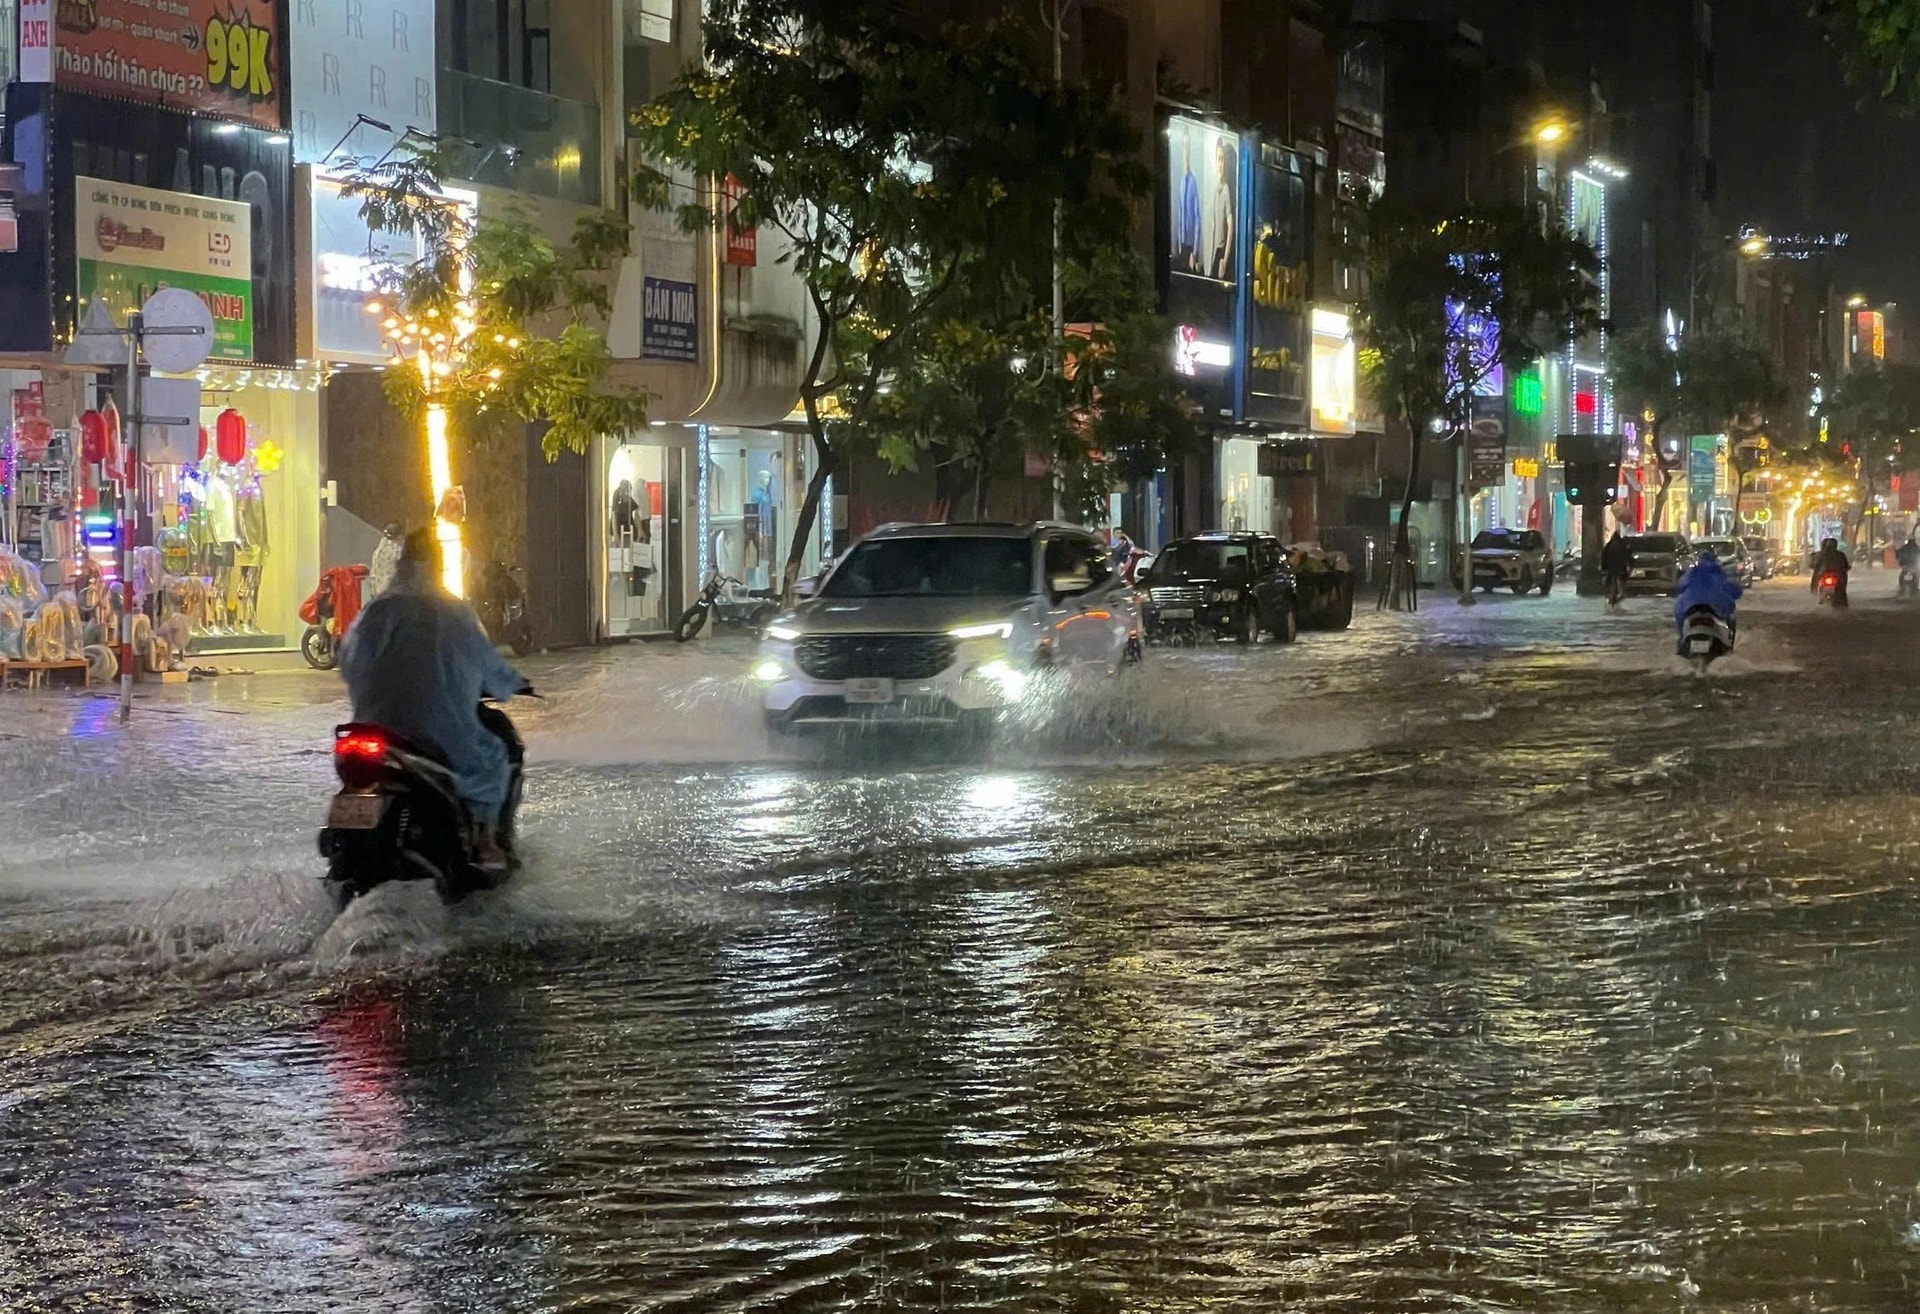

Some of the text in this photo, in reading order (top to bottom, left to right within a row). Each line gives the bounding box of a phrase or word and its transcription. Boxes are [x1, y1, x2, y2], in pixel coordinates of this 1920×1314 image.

[22, 20, 48, 47] ANH
[206, 18, 272, 96] 99K
[150, 66, 186, 95] chưa
[208, 231, 232, 254] LED
[644, 281, 696, 325] BÁN NHÀ
